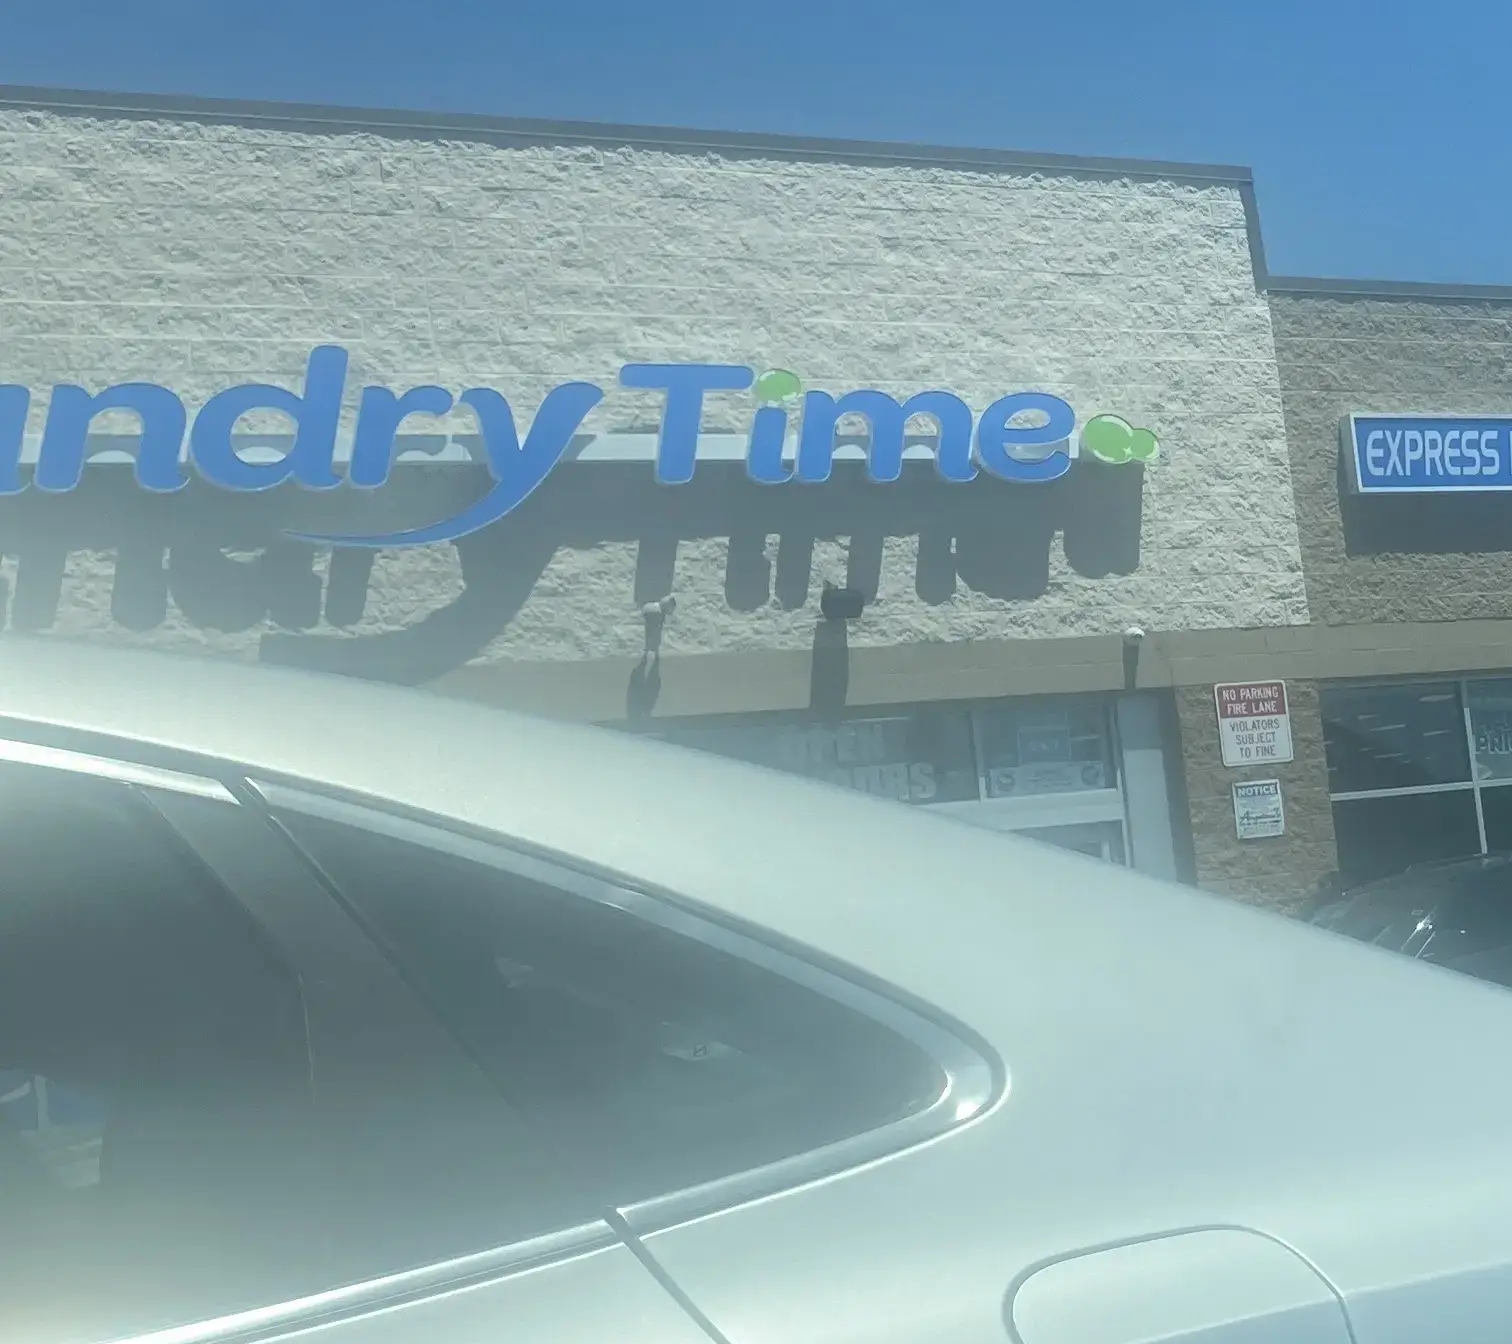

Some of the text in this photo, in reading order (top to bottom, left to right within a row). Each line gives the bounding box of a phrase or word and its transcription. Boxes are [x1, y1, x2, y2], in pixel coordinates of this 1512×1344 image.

[0, 344, 1077, 547] ndry Time
[1366, 429, 1499, 476] EXPRESS
[1222, 686, 1279, 701] NO PARKING
[1227, 701, 1278, 715] FIRE LANE
[1229, 718, 1280, 733] VIOLATORS
[1235, 732, 1276, 746] SUBJECT
[1240, 745, 1276, 758] TO FINE
[1238, 784, 1276, 796] NOTICE
